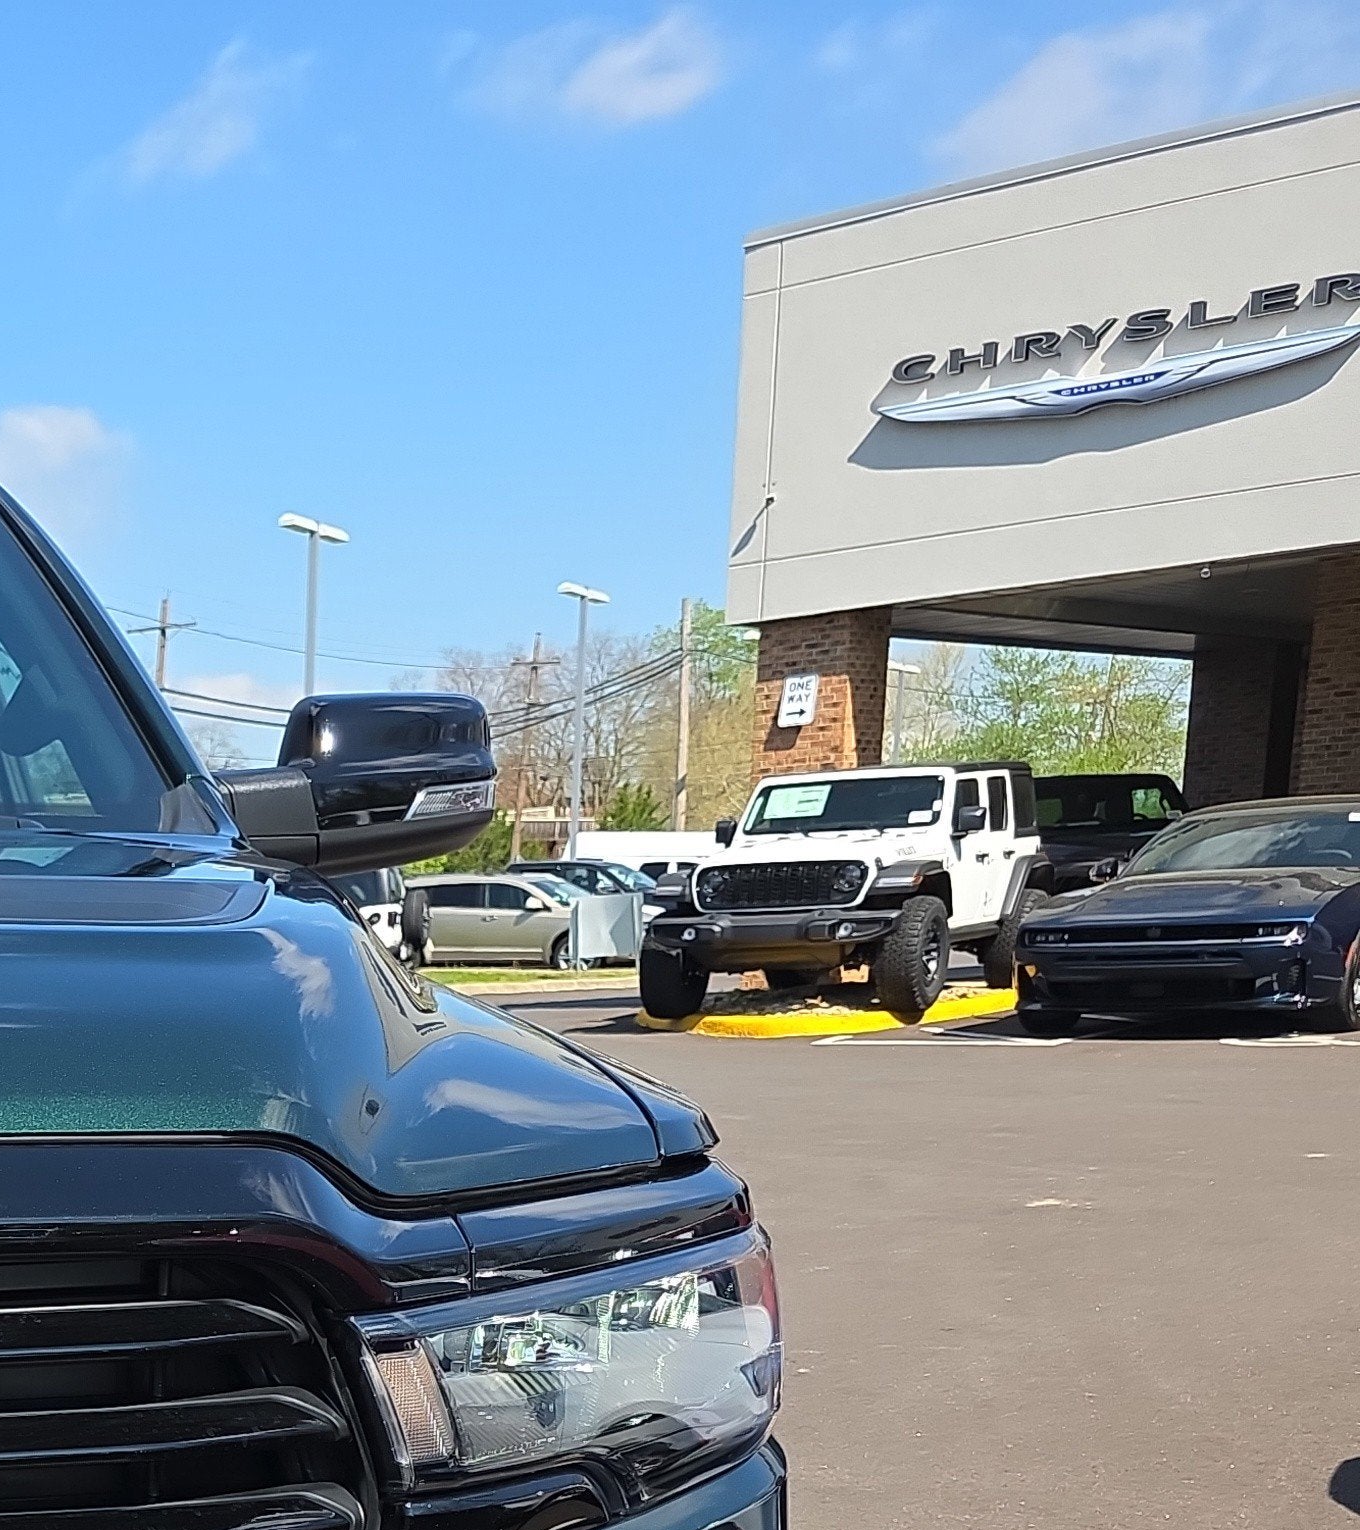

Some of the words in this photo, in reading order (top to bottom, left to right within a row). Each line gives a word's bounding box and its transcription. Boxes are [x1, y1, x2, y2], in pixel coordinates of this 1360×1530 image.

[890, 272, 1360, 385] CHRYSLER
[789, 680, 812, 692] ONE
[787, 693, 811, 704] WAY
